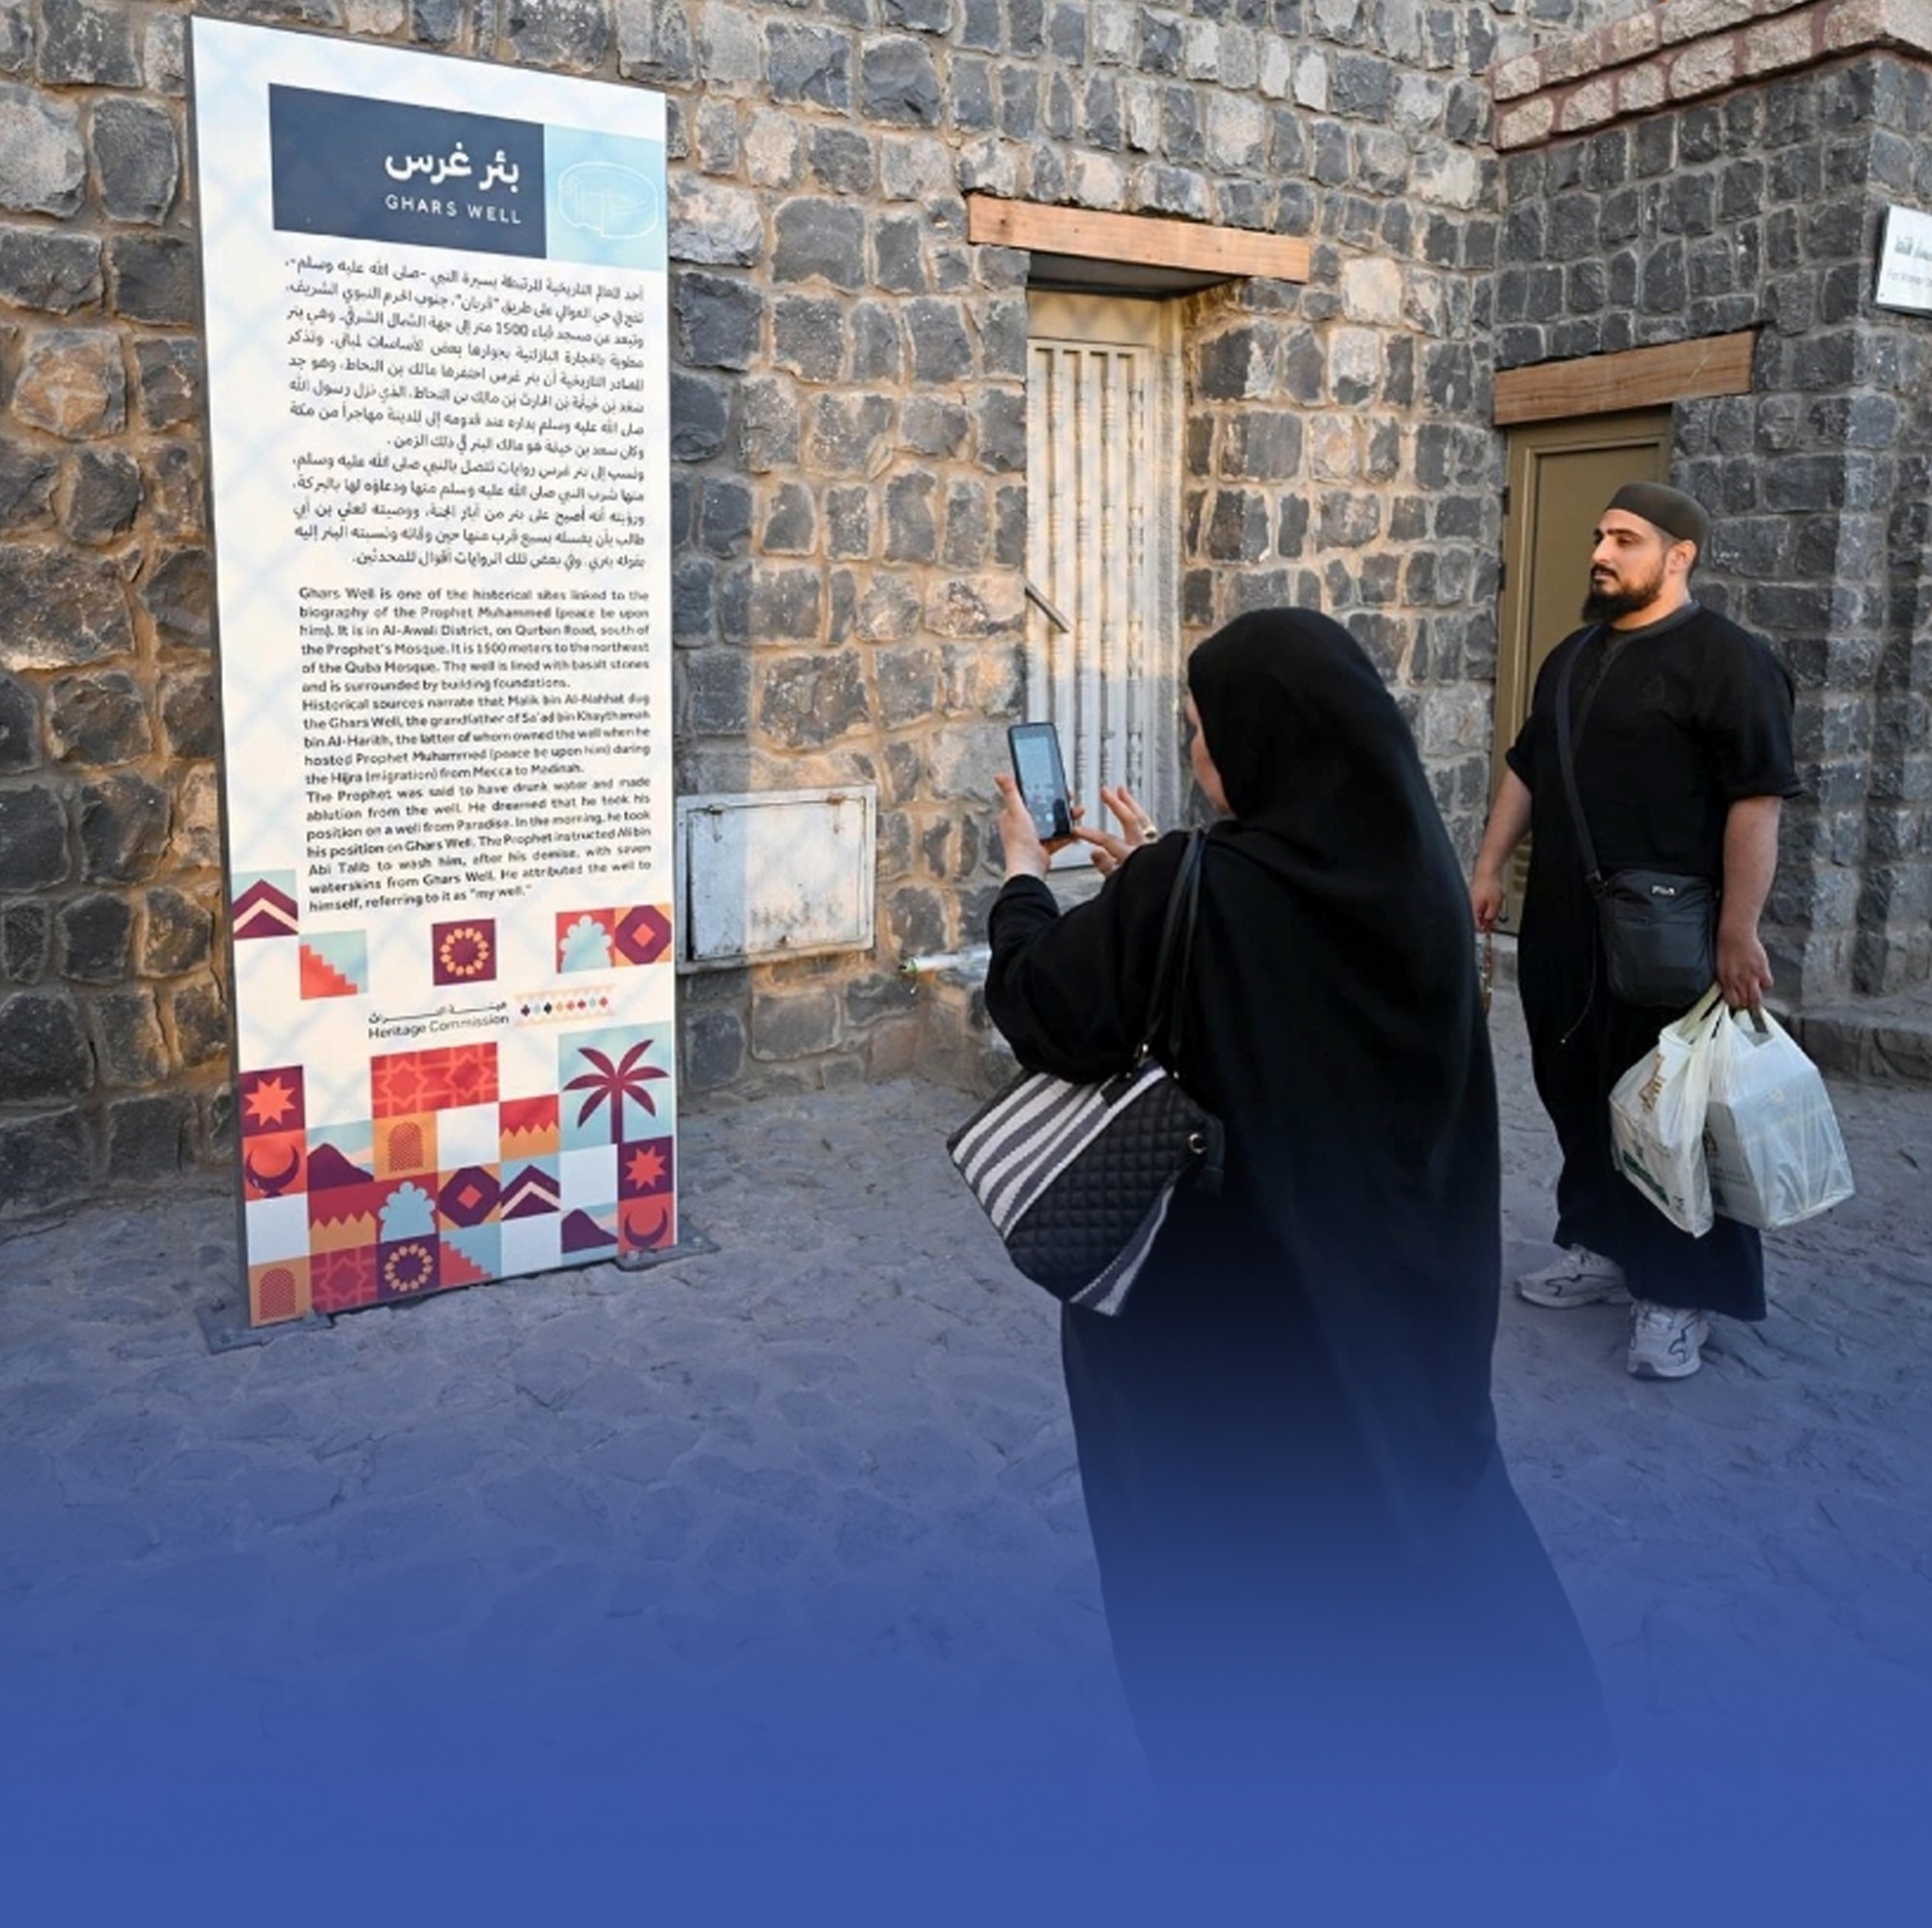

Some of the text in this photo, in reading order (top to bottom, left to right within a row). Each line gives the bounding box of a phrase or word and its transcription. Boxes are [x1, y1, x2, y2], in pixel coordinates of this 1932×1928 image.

[384, 141, 519, 193] بئر غرس
[384, 193, 521, 224] GHARS WELL
[298, 586, 625, 601] Ghars Well is one of the historical to
[298, 606, 649, 621] biography of the Prophet Muhammed upon
[336, 624, 349, 637] It
[351, 625, 363, 637] is
[365, 626, 380, 637] in
[495, 626, 512, 637] on
[514, 624, 561, 637] Qurban
[300, 643, 325, 656] the
[450, 642, 461, 655] It
[462, 641, 474, 655] is
[476, 641, 507, 655] 1500
[507, 642, 553, 654] meters
[301, 661, 316, 674] of
[318, 662, 342, 674] the
[344, 660, 382, 674] Quba
[441, 660, 467, 673] The
[469, 660, 496, 672] well
[301, 678, 439, 694] and is surrounded by
[301, 695, 539, 712] Historical sources narrate that Malik
[302, 717, 327, 730] the
[327, 717, 369, 729] Ghars
[405, 715, 428, 727] the
[303, 735, 326, 750] bin
[395, 733, 417, 746] the
[419, 732, 455, 745] latter
[457, 730, 471, 743] of
[471, 731, 511, 743] whom
[554, 728, 576, 740] the
[303, 752, 353, 767] hosted
[355, 751, 409, 766] Prophet
[412, 749, 487, 762] Muhammed
[532, 747, 549, 759] be
[550, 747, 582, 759] upon
[611, 744, 651, 756] during
[304, 773, 328, 785] the
[329, 771, 363, 786] Hijra
[439, 766, 471, 779] from
[471, 765, 513, 779] Mecca
[514, 765, 528, 777] to
[305, 780, 548, 804] The Prophet was said to have drunk
[305, 808, 362, 822] ablution
[367, 807, 401, 819] from
[405, 804, 428, 817] the
[468, 801, 486, 813] He
[491, 798, 547, 812] dreamed
[550, 797, 576, 809] that
[305, 826, 363, 843] position
[364, 826, 382, 837] on
[384, 825, 393, 836] a
[394, 822, 421, 836] well
[422, 820, 455, 833] from
[514, 816, 528, 828] In
[528, 815, 550, 828] the
[306, 832, 553, 860] his position on Ghars The Prophet
[307, 864, 331, 877] Abi
[337, 861, 370, 874] Talib
[376, 861, 392, 872] to
[398, 856, 432, 870] wash
[471, 852, 502, 865] after
[507, 850, 526, 863] his
[585, 845, 611, 857] with
[616, 844, 651, 855] seven
[308, 879, 382, 894] waterskins
[386, 875, 419, 889] from
[421, 872, 461, 887] Ghars
[499, 868, 518, 881] He
[522, 864, 582, 878] attributed
[587, 863, 607, 874] the
[364, 893, 424, 909] referring
[424, 892, 440, 904] to
[440, 890, 451, 902] it
[452, 891, 467, 901] as
[367, 1008, 509, 1040] Heritage Commission
